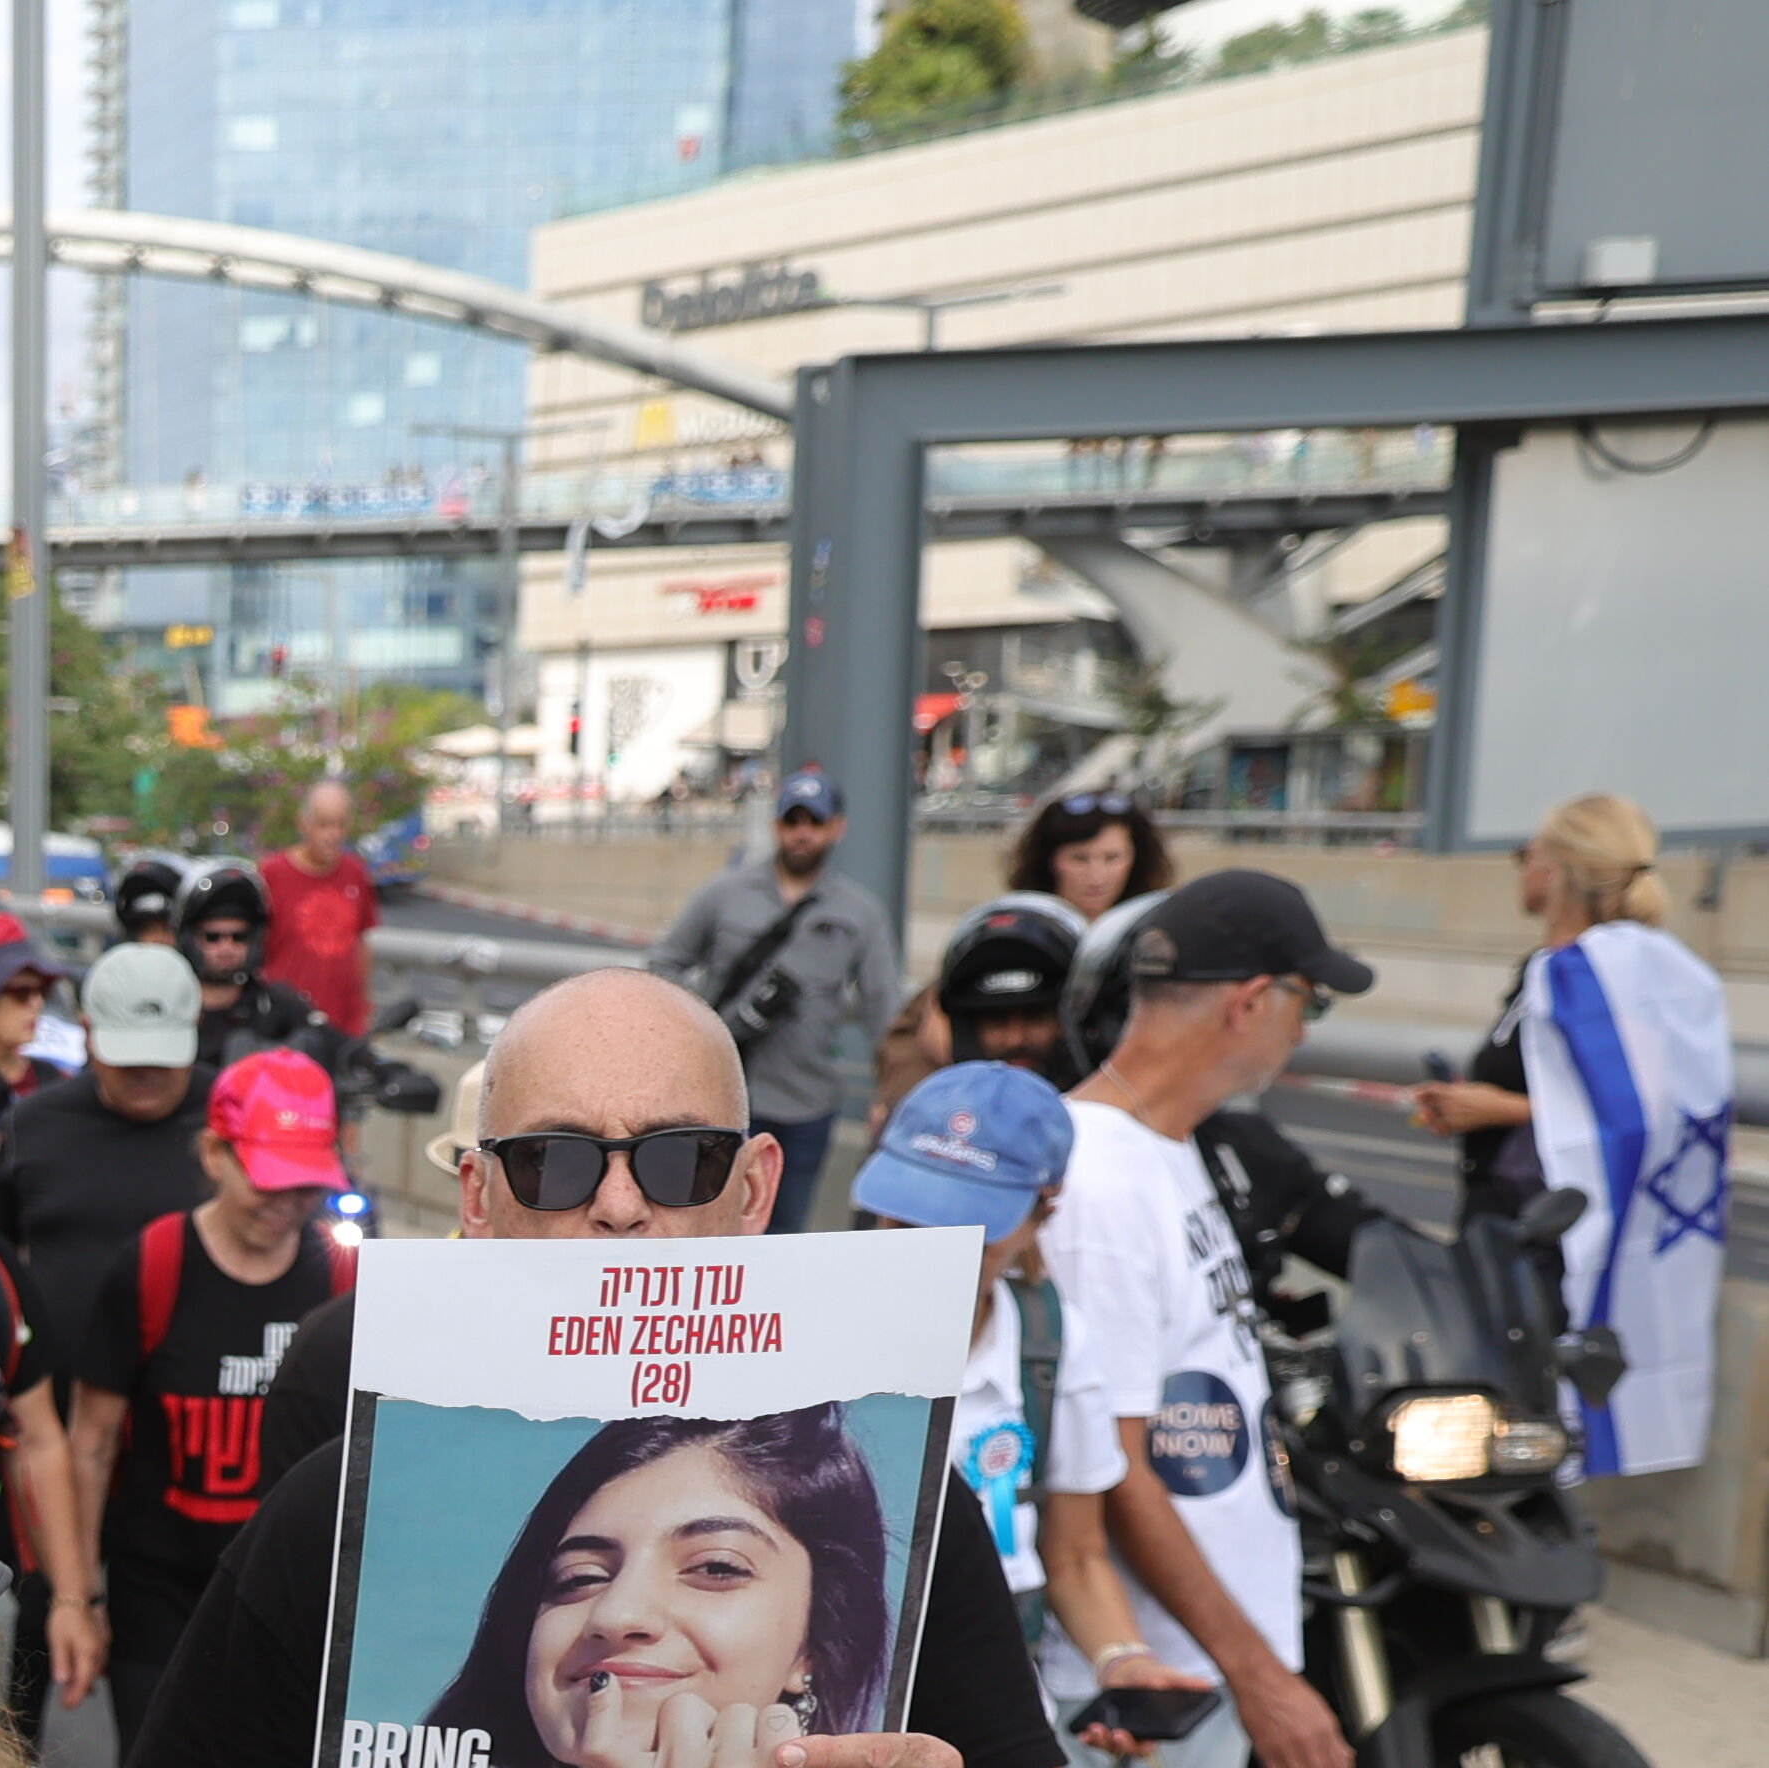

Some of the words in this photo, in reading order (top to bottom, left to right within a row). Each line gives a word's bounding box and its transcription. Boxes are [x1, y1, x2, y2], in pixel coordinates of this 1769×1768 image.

[600, 1266, 685, 1308] זכריה
[693, 1265, 745, 1310] עדן
[547, 1316, 623, 1356] EDEN
[629, 1312, 783, 1355] ZECHARYA
[631, 1361, 692, 1408] (28)
[1147, 1402, 1242, 1431] HOME
[161, 1392, 265, 1495] שיו
[1153, 1429, 1237, 1459] NOW
